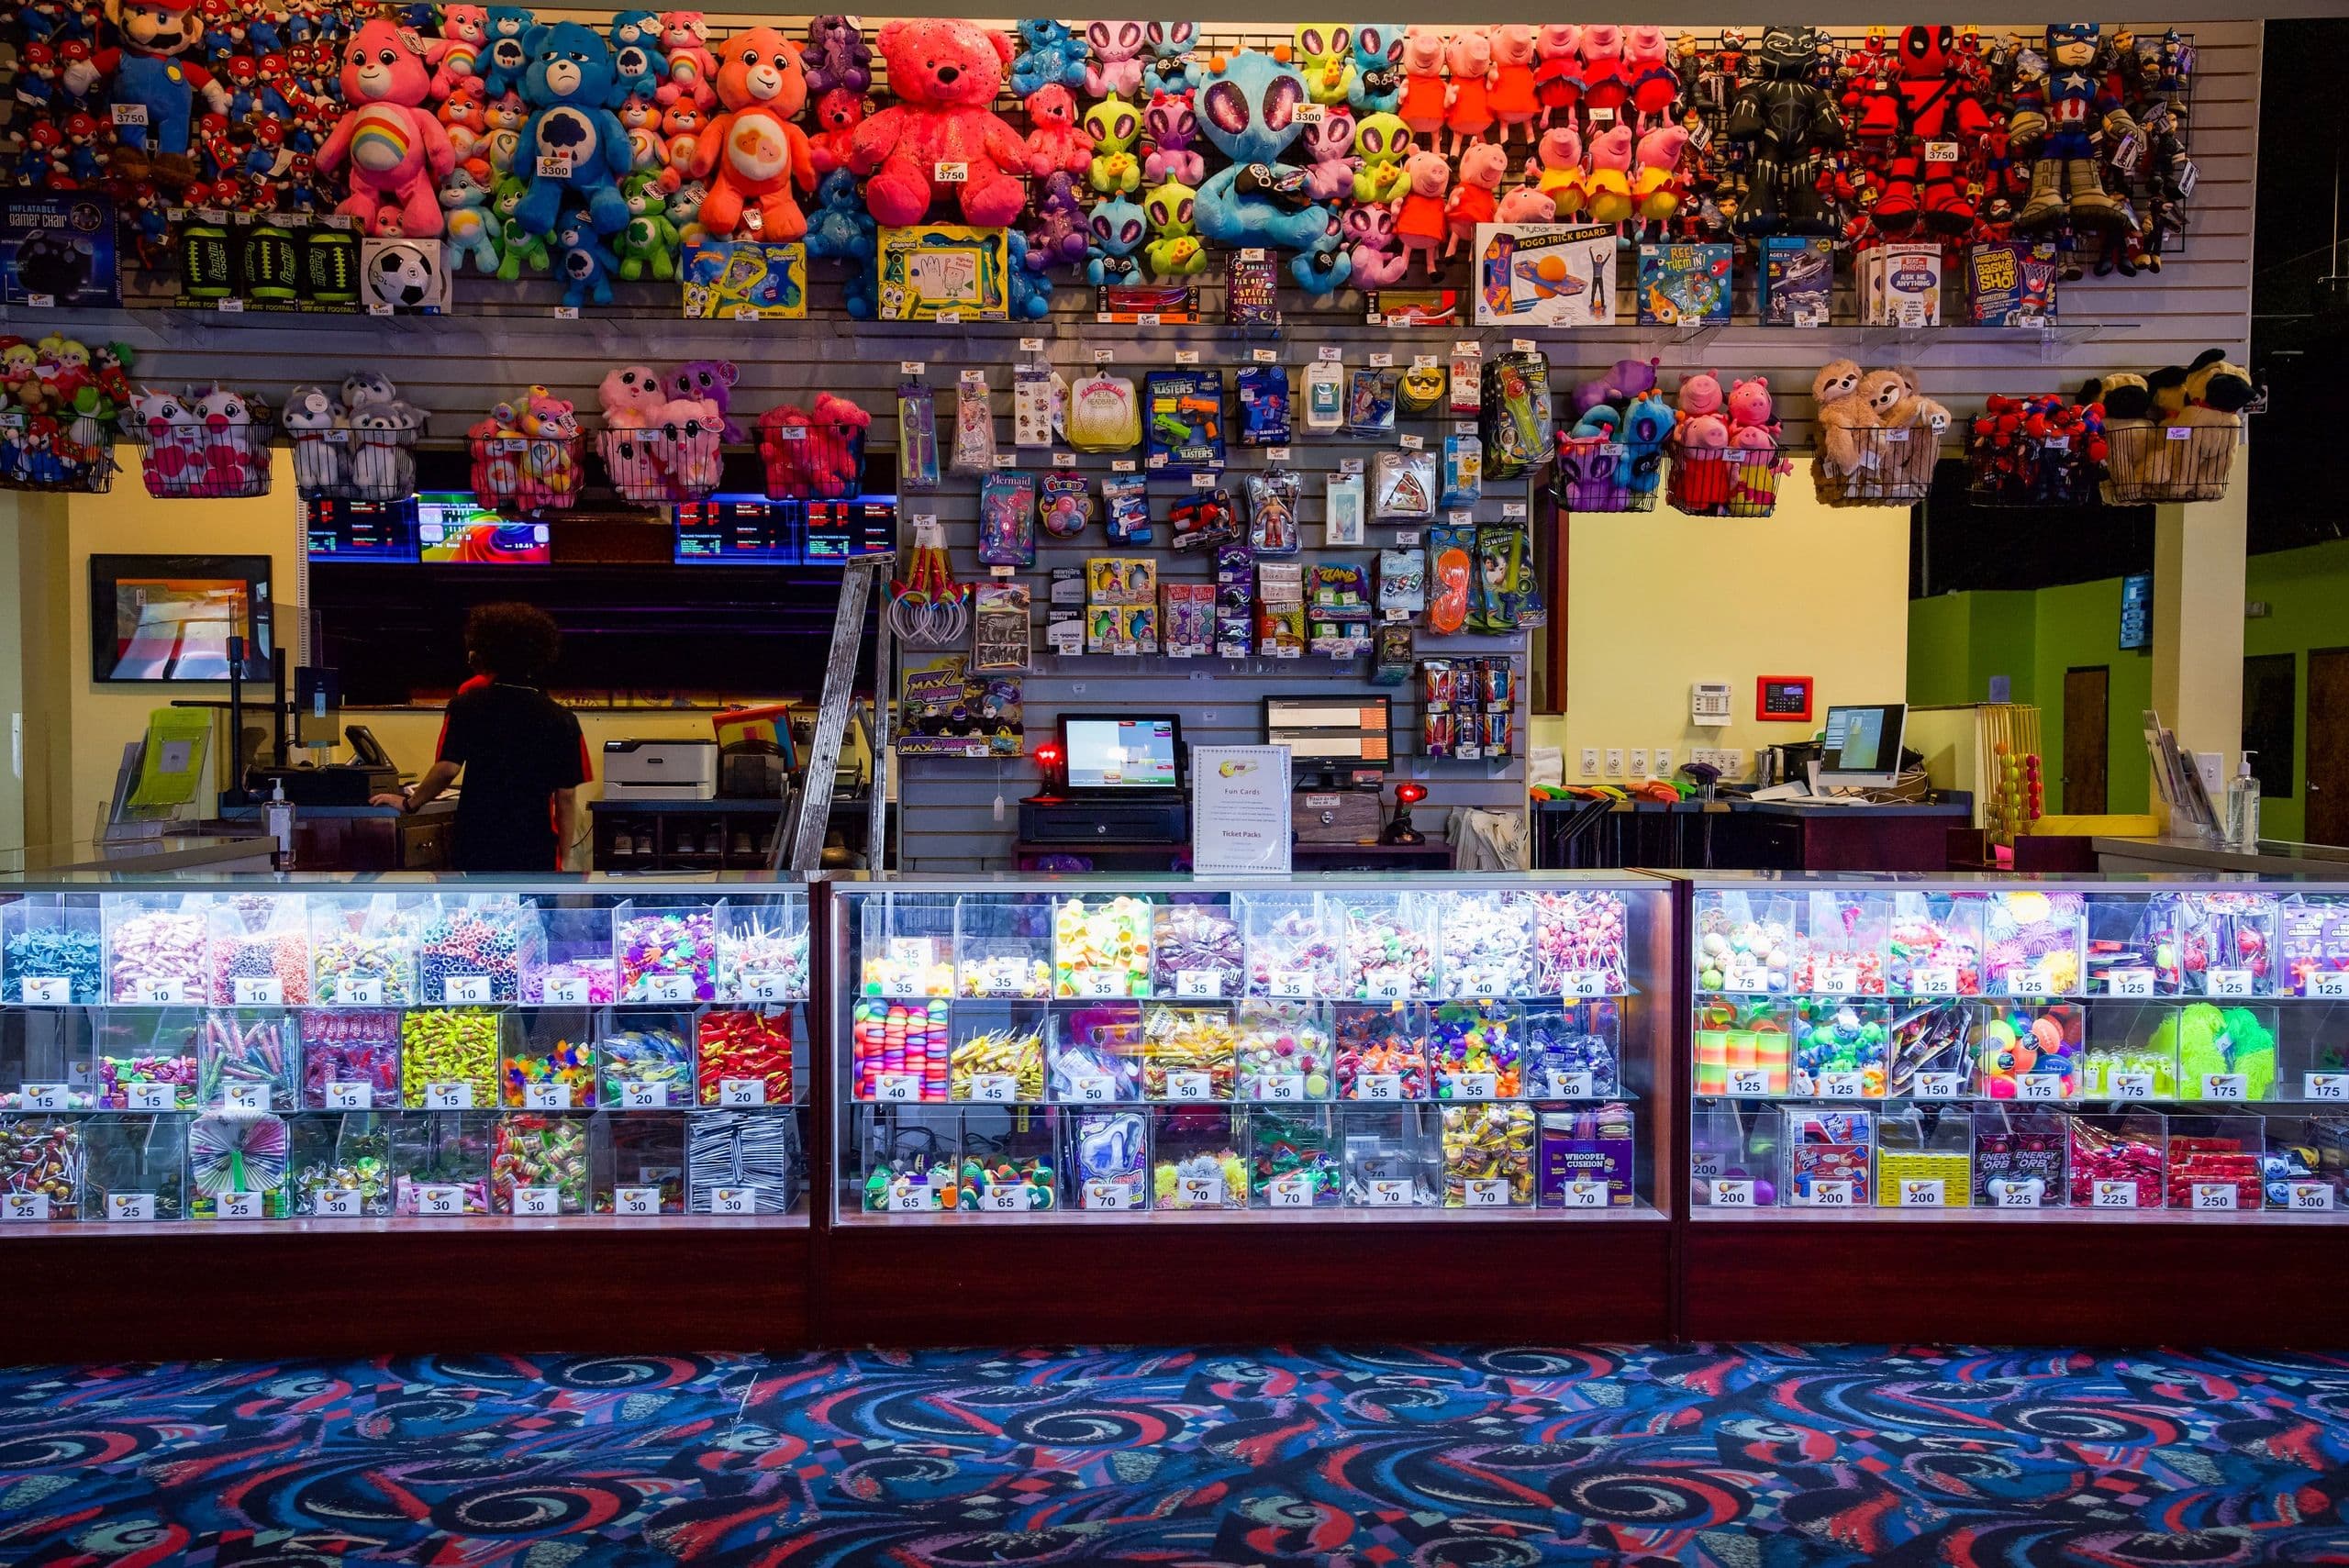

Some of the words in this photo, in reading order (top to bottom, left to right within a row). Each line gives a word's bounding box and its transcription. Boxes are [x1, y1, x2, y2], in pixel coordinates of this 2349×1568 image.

[117, 114, 144, 124] 3750
[1296, 113, 1321, 122] 3300
[1929, 150, 1954, 160] 3750
[540, 166, 569, 176] 3300
[939, 171, 964, 181] 3750
[9, 205, 57, 214] INFLATABLE
[9, 214, 40, 228] gamer
[1520, 238, 1546, 249] POGO
[1547, 230, 1573, 245] TRICK
[1575, 227, 1607, 239] BOARD
[1671, 246, 1696, 261] REEL
[1665, 258, 1692, 272] THEM
[1239, 288, 1268, 297] SPACE
[1237, 366, 1258, 377] NERF
[1152, 384, 1194, 395] BLASTERS
[1181, 449, 1215, 459] BLASTERS
[985, 474, 1030, 487] Mermaid
[910, 675, 951, 690] MAX
[902, 744, 932, 752] MAX
[903, 949, 918, 958] 35
[996, 978, 1011, 986] 35
[1739, 979, 1753, 987] 75
[1828, 982, 1842, 990] 90
[896, 984, 912, 993] 35
[1096, 984, 1111, 993] 35
[1192, 984, 1207, 993] 35
[1285, 984, 1299, 994] 35
[1381, 987, 1397, 995] 40
[1475, 983, 1492, 994] 40
[1576, 983, 1593, 994] 40
[1925, 983, 1947, 991] 125
[2019, 983, 2041, 991] 125
[2121, 984, 2143, 993] 125
[2219, 983, 2243, 993] 125
[2318, 985, 2342, 994] 125
[42, 991, 50, 1000] 5
[152, 990, 169, 1001] 10
[250, 990, 267, 1001] 10
[351, 992, 367, 1001] 10
[461, 990, 475, 998] 10
[558, 992, 573, 1000] 15
[662, 989, 677, 998] 15
[757, 988, 773, 996] 15
[1181, 1086, 1197, 1097] 50
[1275, 1086, 1290, 1097] 50
[1371, 1086, 1387, 1097] 55
[1467, 1086, 1482, 1095] 55
[1563, 1084, 1579, 1095] 60
[1737, 1083, 1760, 1091] 125
[1831, 1085, 1853, 1094] 125
[1925, 1085, 1948, 1094] 150
[2027, 1087, 2051, 1095] 175
[2120, 1086, 2143, 1096] 175
[2213, 1087, 2236, 1095] 175
[2316, 1087, 2339, 1096] 175
[889, 1087, 906, 1098] 40
[985, 1089, 1001, 1098] 45
[1085, 1088, 1101, 1099] 50
[35, 1095, 53, 1107] 15
[143, 1095, 161, 1106] 15
[239, 1098, 255, 1106] 15
[340, 1095, 357, 1106] 15
[442, 1096, 458, 1105] 15
[540, 1096, 556, 1105] 15
[636, 1095, 651, 1104] 20
[735, 1093, 751, 1102] 20
[2015, 1151, 2057, 1161] ENERGY
[1566, 1160, 1604, 1168] CUSHION
[1983, 1160, 2010, 1169] ORB
[2019, 1159, 2046, 1169] ORB
[1694, 1164, 1717, 1174] 200
[1193, 1191, 1208, 1200] 70
[1284, 1193, 1300, 1204] 70
[1384, 1193, 1398, 1201] 70
[1479, 1193, 1495, 1202] 70
[1579, 1195, 1594, 1204] 70
[1720, 1194, 1744, 1202] 200
[1819, 1191, 1842, 1203] 200
[1910, 1194, 1934, 1202] 200
[2007, 1195, 2031, 1204] 225
[2103, 1195, 2127, 1204] 225
[433, 1201, 449, 1210] 30
[726, 1201, 740, 1210] 30
[902, 1197, 918, 1208] 65
[998, 1198, 1014, 1207] 65
[1099, 1195, 1116, 1207] 70
[2203, 1197, 2227, 1206] 250
[2299, 1197, 2324, 1207] 300
[231, 1206, 248, 1214] 25
[330, 1203, 346, 1211] 30
[529, 1202, 544, 1210] 30
[630, 1202, 646, 1211] 30
[17, 1207, 34, 1216] 25
[123, 1207, 139, 1217] 25
